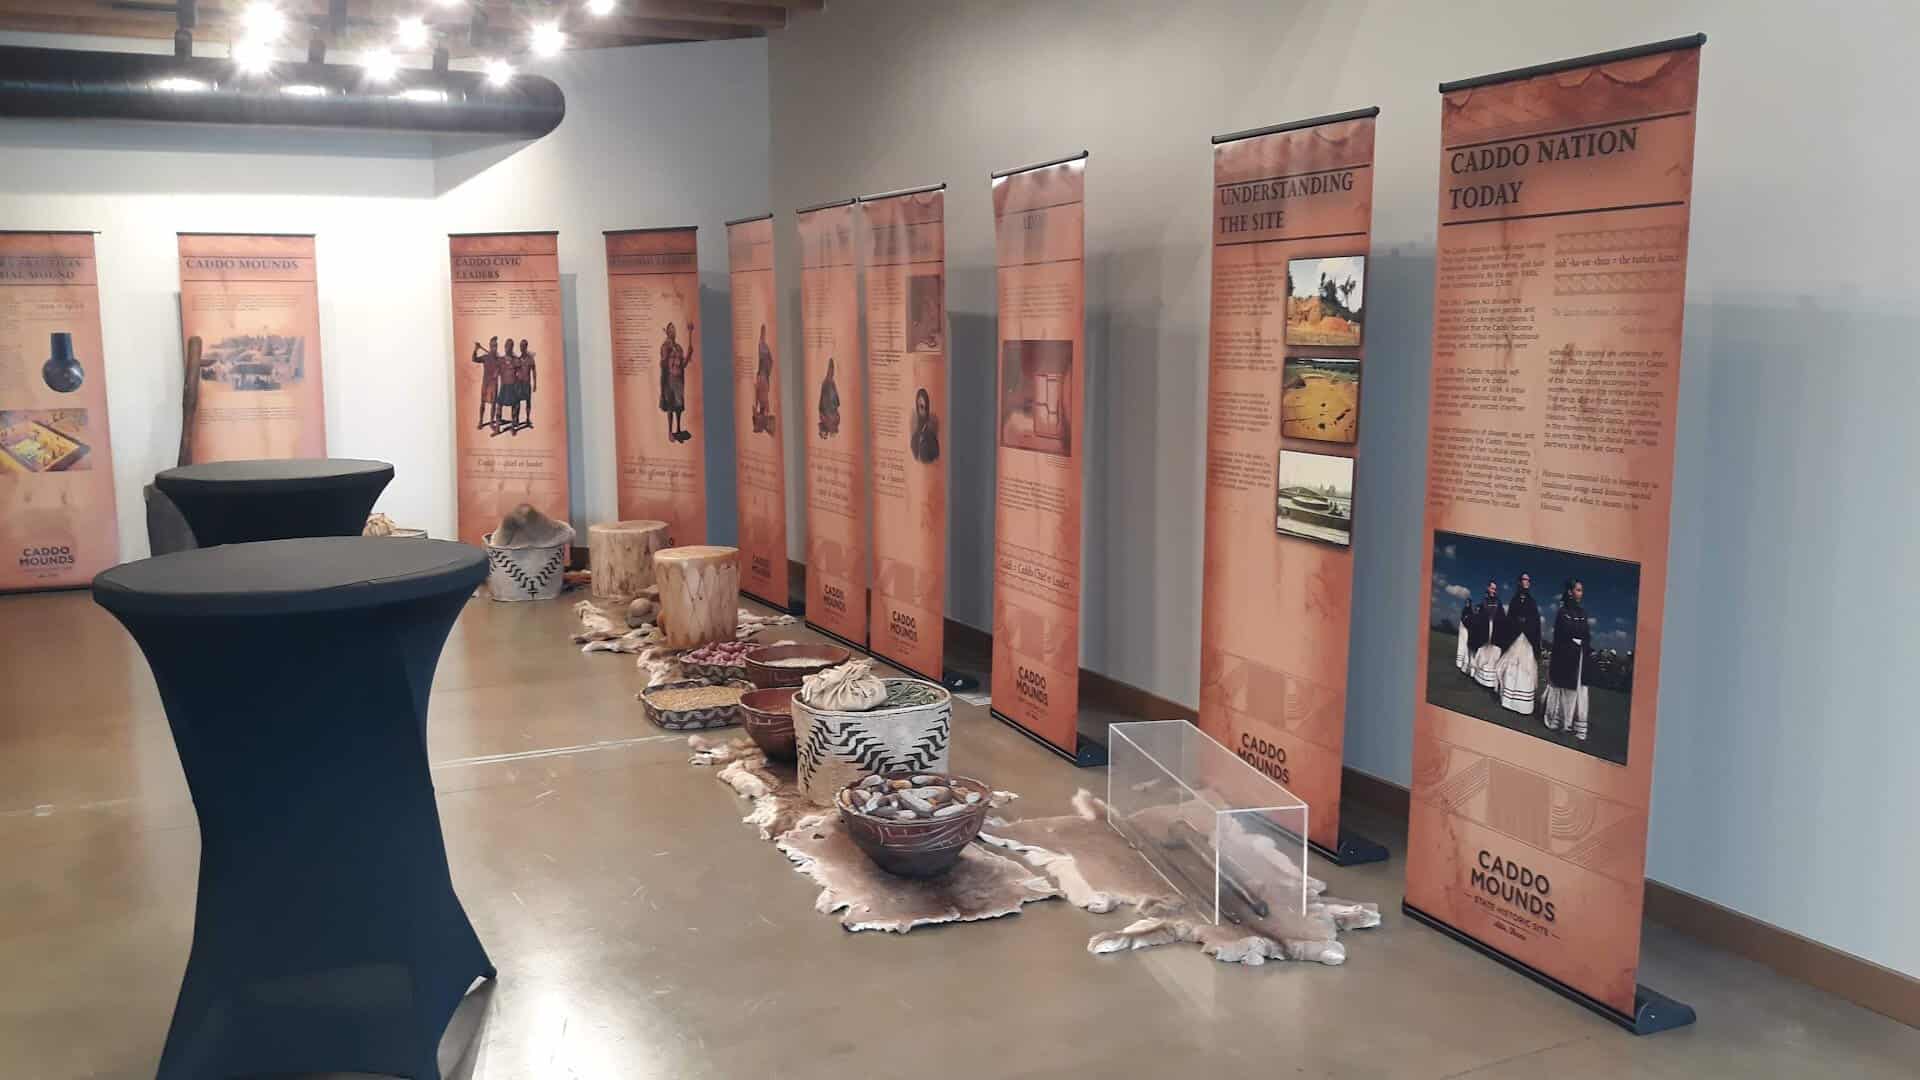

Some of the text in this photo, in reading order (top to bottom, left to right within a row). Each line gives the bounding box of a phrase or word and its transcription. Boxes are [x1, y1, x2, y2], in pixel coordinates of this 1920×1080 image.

[1450, 127, 1640, 174] CADDO NATION
[1220, 172, 1353, 206] UNDERSTANDING
[1448, 181, 1523, 210] TODAY
[1219, 210, 1285, 234] THE SITE
[186, 258, 299, 270] CADDO MOUNDS
[455, 256, 490, 267] CADDO
[455, 270, 500, 280] LEADERS
[19, 555, 75, 566] MOUNDS
[23, 546, 70, 557] CADDO
[890, 621, 918, 643] MOUNDS
[892, 610, 917, 629] CADDO
[1018, 665, 1047, 690] CADDO
[1016, 679, 1049, 707] MOUNDS
[1241, 732, 1287, 764] CADDO
[1237, 746, 1290, 785] MOUNDS
[1478, 850, 1550, 895] CADDO
[1471, 868, 1556, 922] MOUNDS
